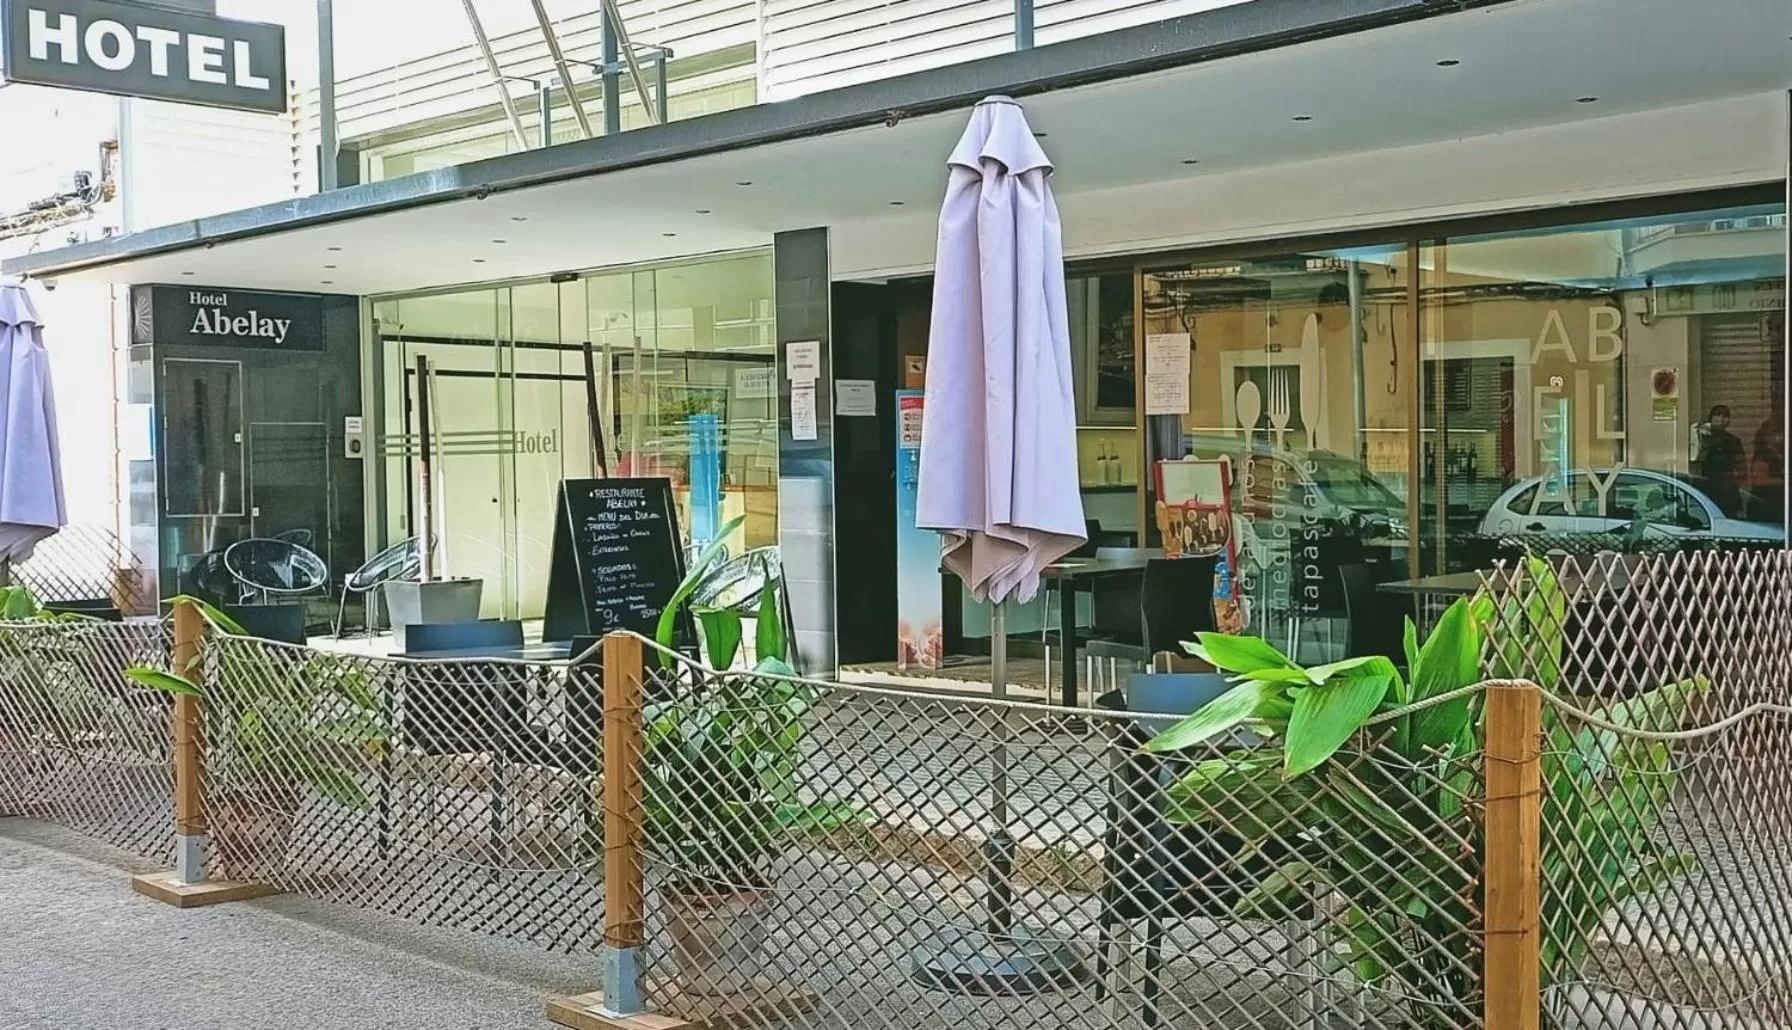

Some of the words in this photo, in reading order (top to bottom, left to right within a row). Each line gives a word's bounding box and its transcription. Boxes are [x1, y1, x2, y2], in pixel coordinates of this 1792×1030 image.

[28, 8, 270, 90] HOTEL
[189, 291, 228, 306] Hotel
[189, 307, 292, 344] Abelay
[1531, 306, 1623, 364] AB
[514, 429, 558, 454] Hotel
[1529, 461, 1627, 517] AY
